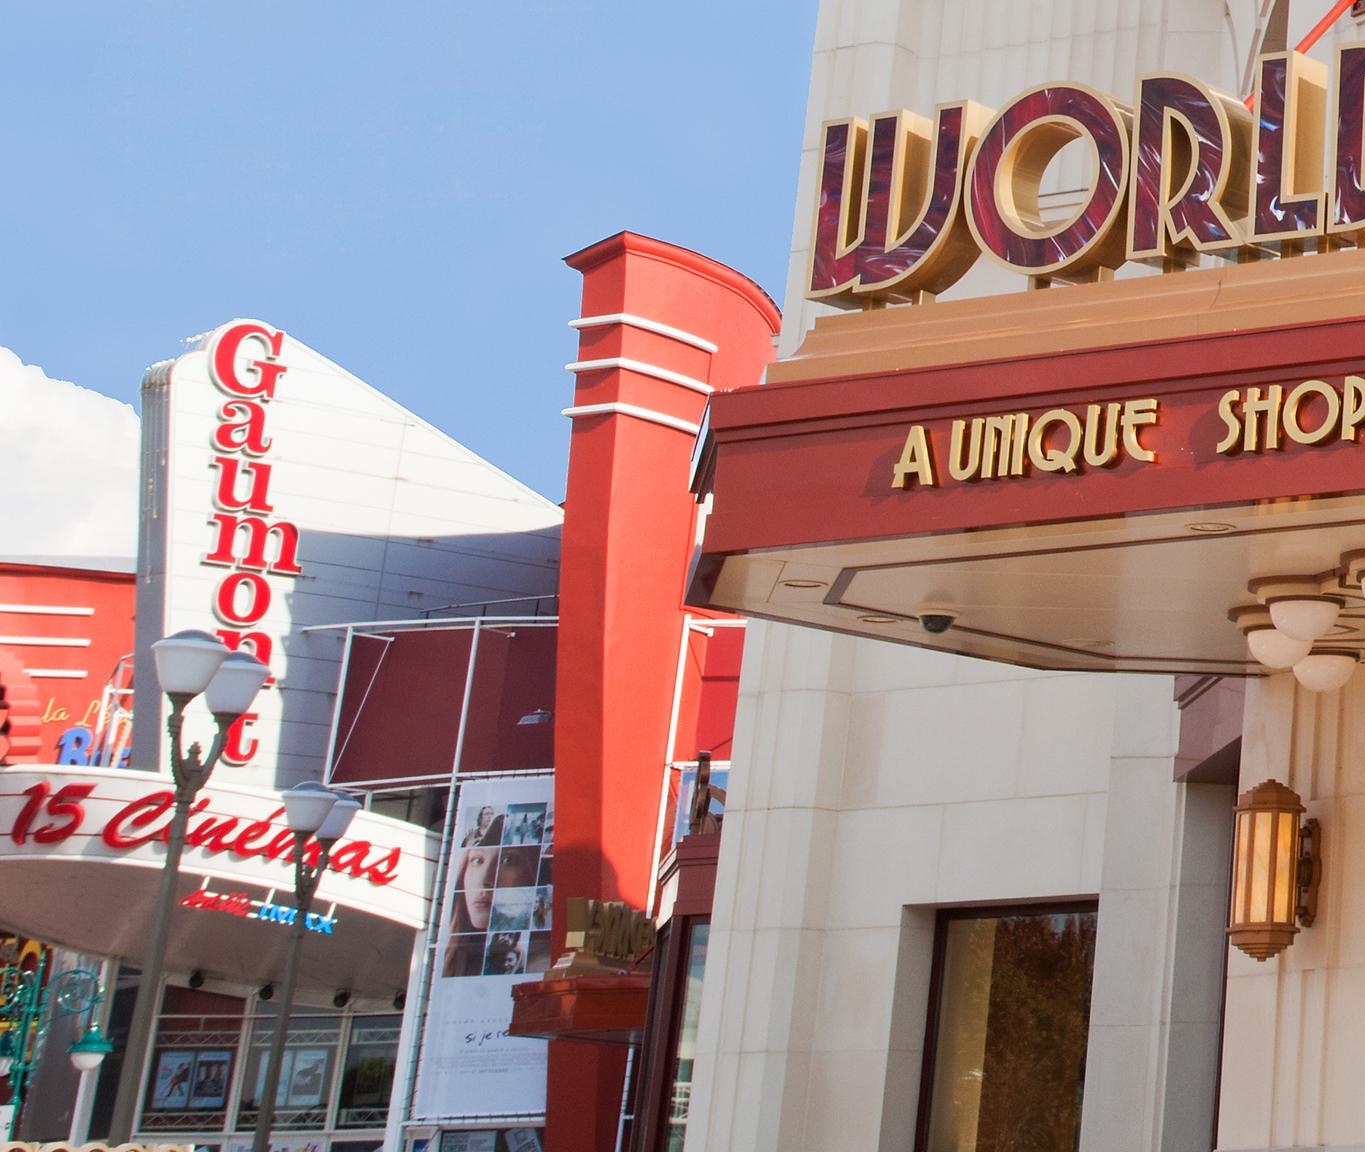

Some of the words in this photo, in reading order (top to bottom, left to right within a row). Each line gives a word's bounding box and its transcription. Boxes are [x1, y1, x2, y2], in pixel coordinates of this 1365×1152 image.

[891, 425, 933, 488] A
[949, 398, 1159, 482] UNIQUE
[201, 321, 302, 765] Gaumont
[12, 779, 98, 846] 15
